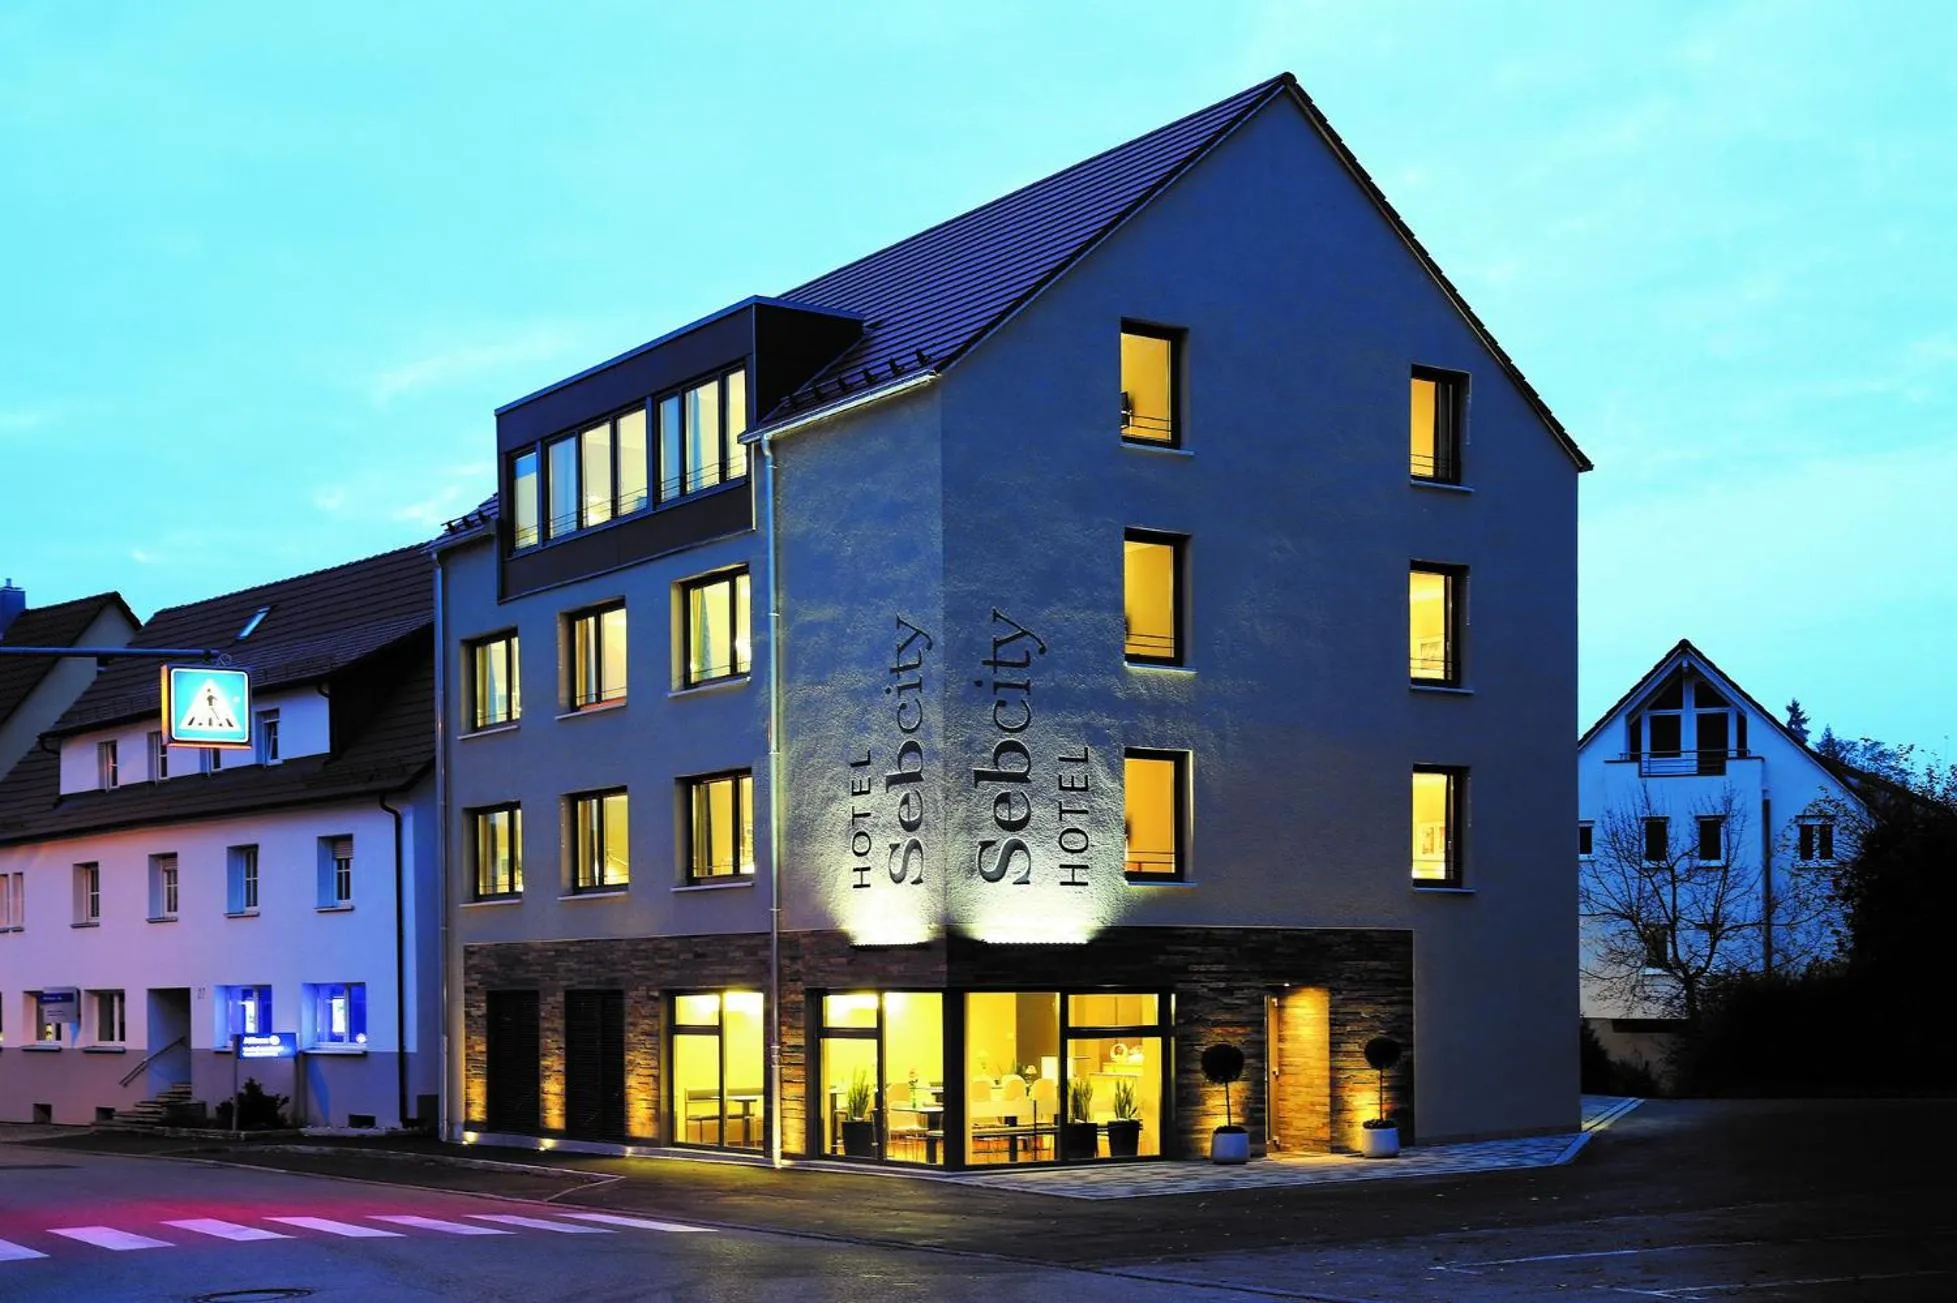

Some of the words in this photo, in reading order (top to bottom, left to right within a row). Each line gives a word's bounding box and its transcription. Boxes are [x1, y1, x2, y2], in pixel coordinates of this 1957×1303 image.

[851, 750, 871, 889] HOTEL
[885, 614, 933, 885] Sebcity
[973, 608, 1046, 885] Sebcity
[1058, 747, 1089, 887] HOTEL
